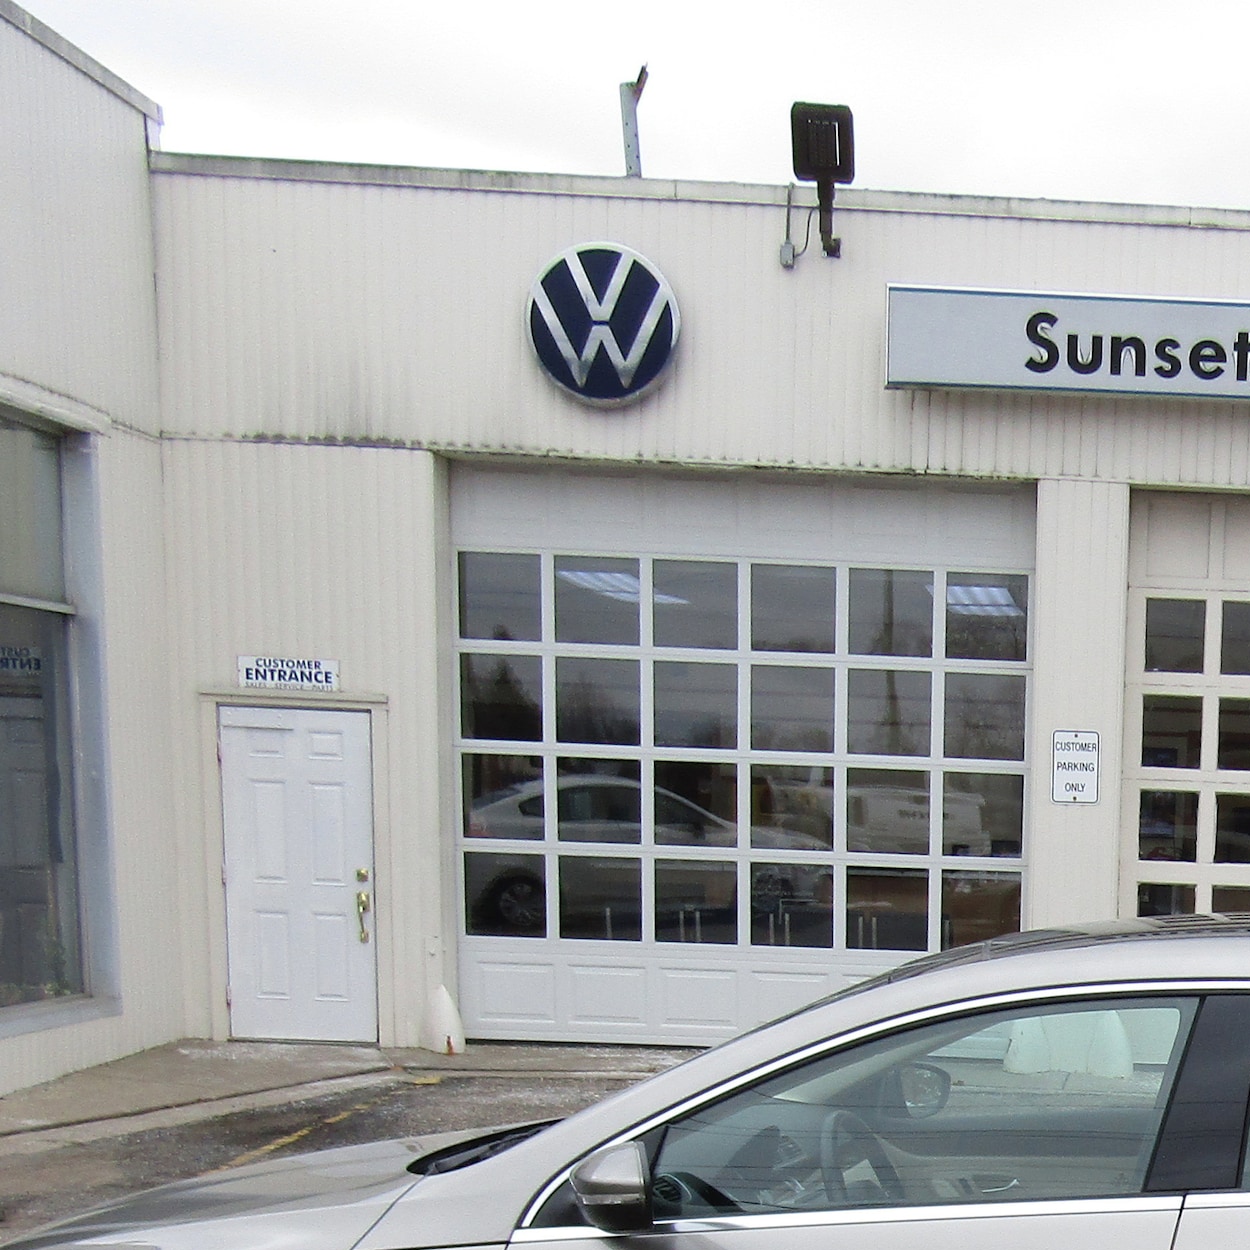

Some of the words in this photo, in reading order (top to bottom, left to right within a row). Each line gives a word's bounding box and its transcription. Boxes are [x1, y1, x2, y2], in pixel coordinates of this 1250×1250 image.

[255, 658, 322, 670] CUSTOMER
[245, 668, 333, 684] ENTRANCE
[1055, 741, 1097, 752] CUSTOMER
[1056, 761, 1095, 772] PARKING
[1064, 782, 1086, 793] ONLY
